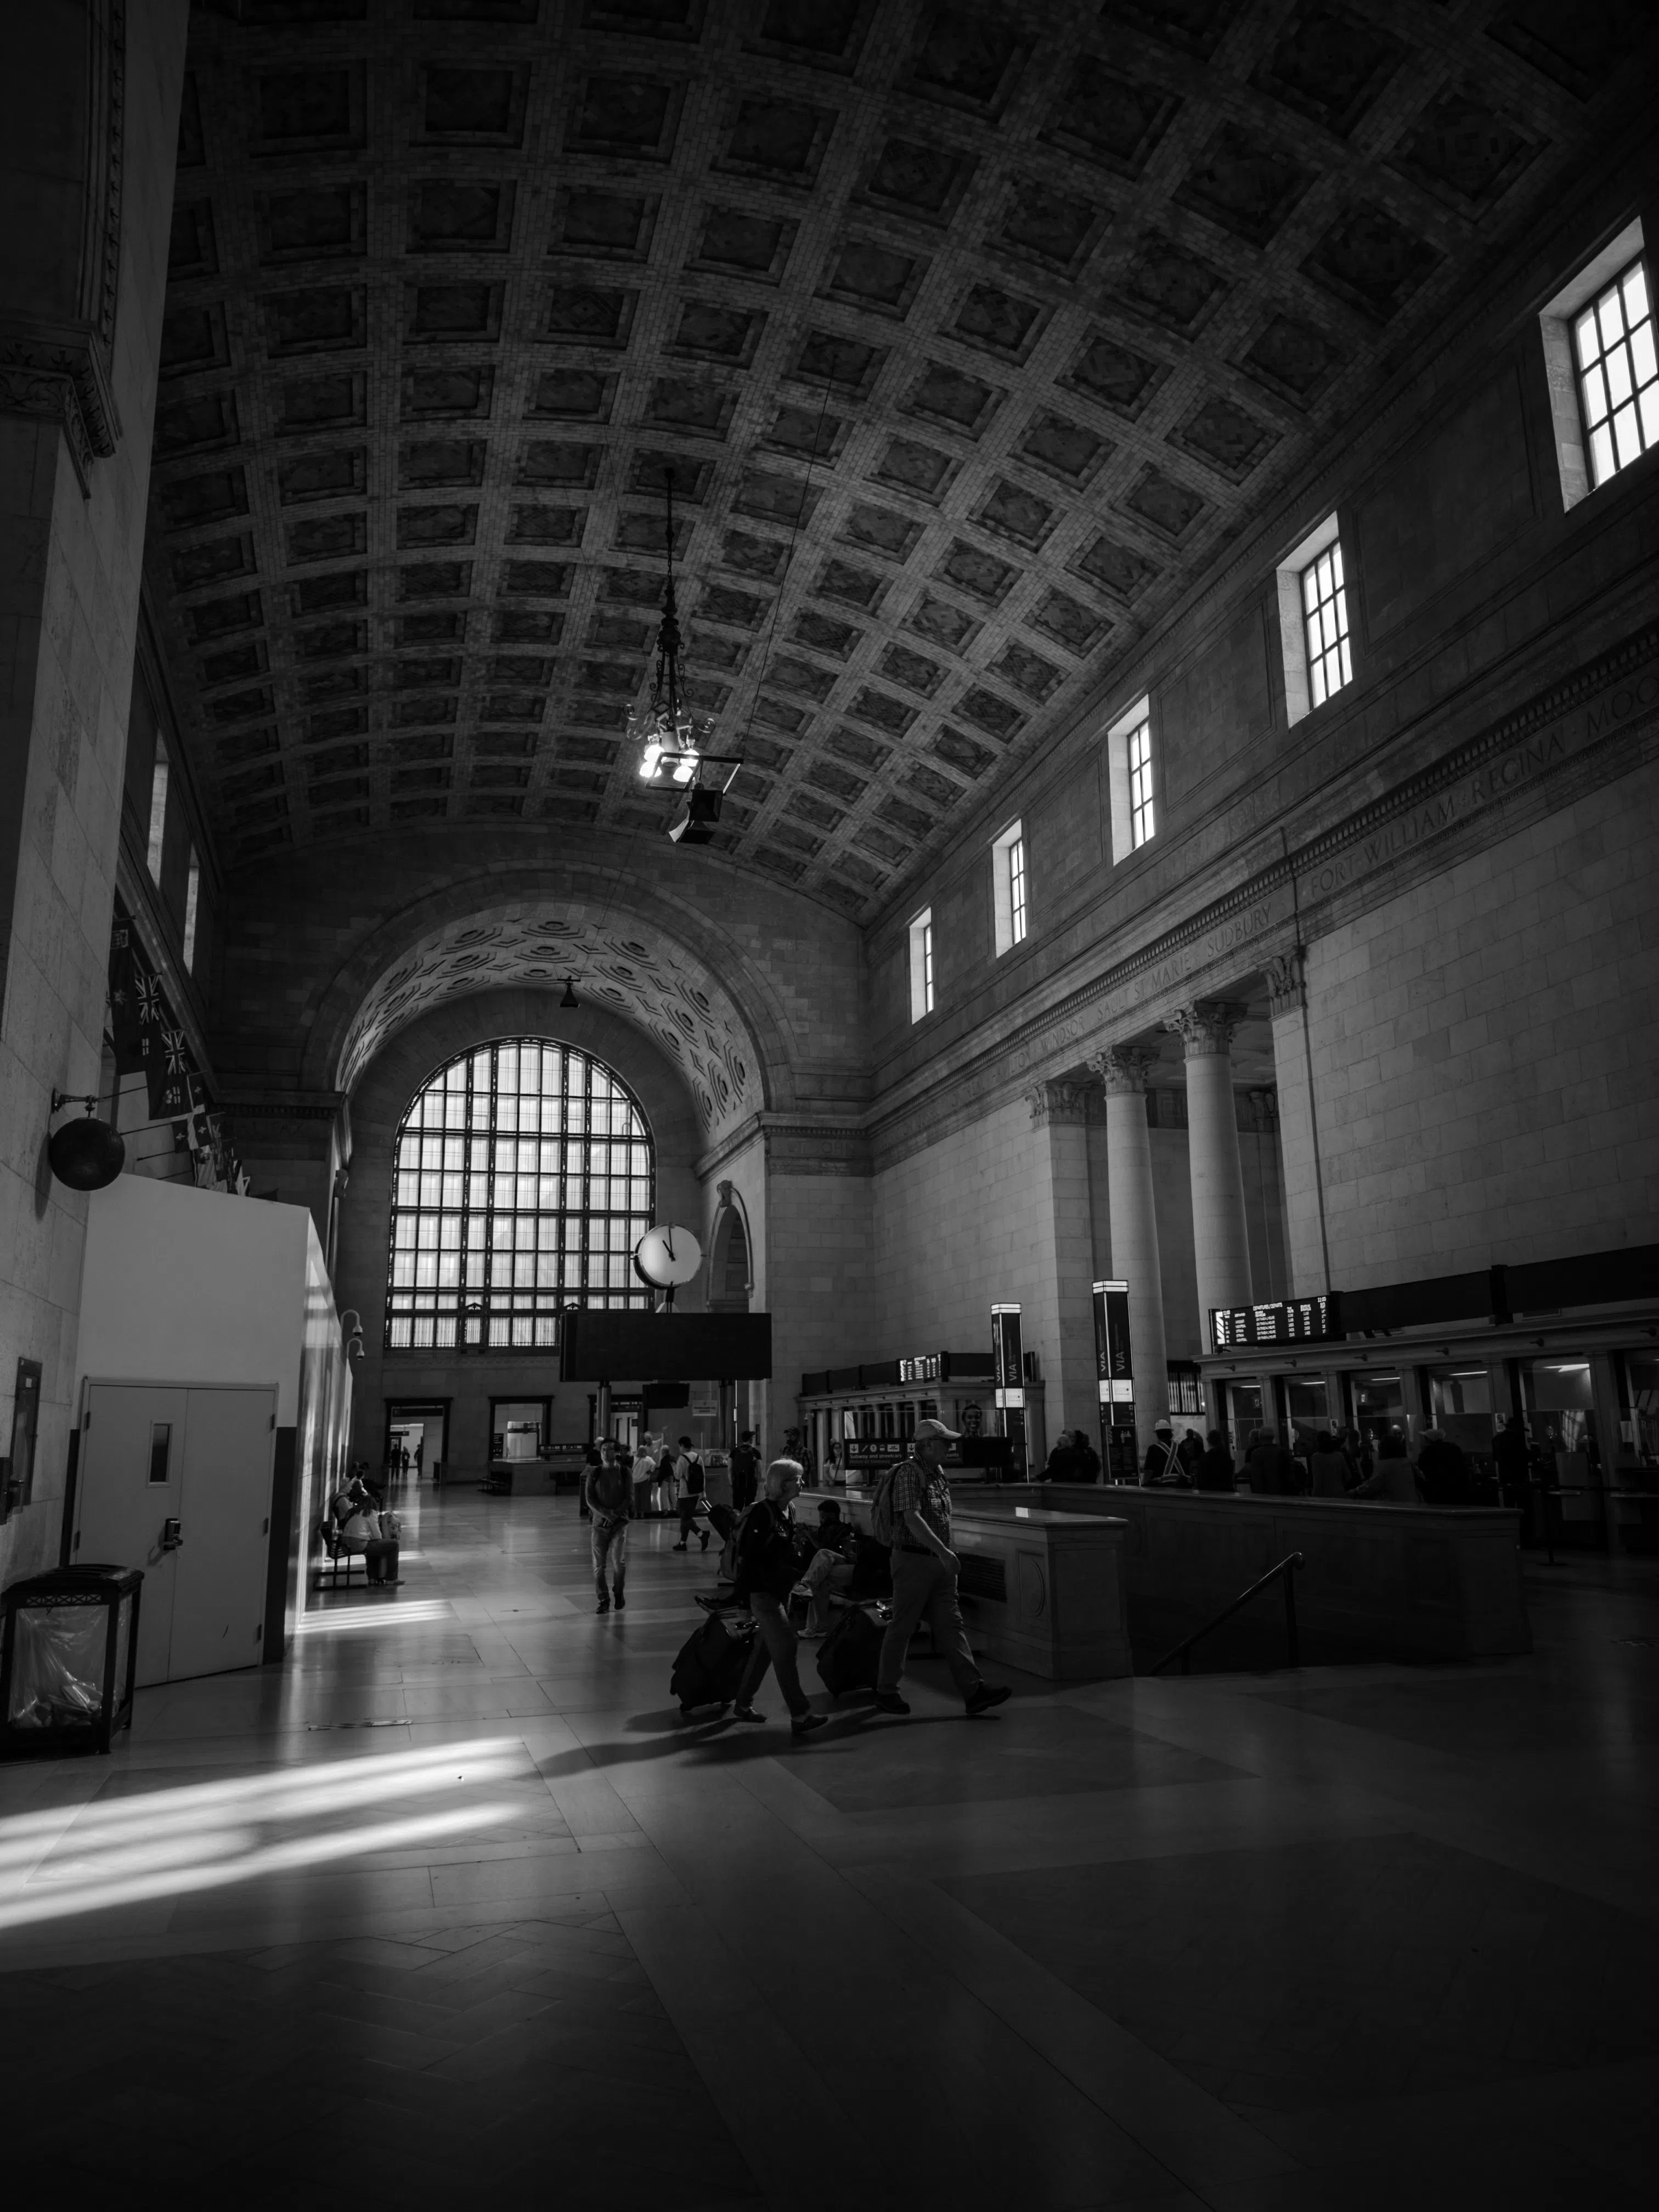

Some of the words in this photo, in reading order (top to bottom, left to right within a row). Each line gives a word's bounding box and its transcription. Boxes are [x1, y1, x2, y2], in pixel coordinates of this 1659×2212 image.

[1041, 1016, 1085, 1052] WINDSOR
[1098, 988, 1129, 1020] SAULT
[1151, 951, 1191, 986] MARIE
[1206, 902, 1272, 957] SUDBURY
[1310, 857, 1356, 898] FORT
[1363, 798, 1457, 866] WILLIAM
[1470, 733, 1566, 804] REGINA
[1008, 1363, 1018, 1381] VIA
[1115, 1351, 1126, 1372] VIA
